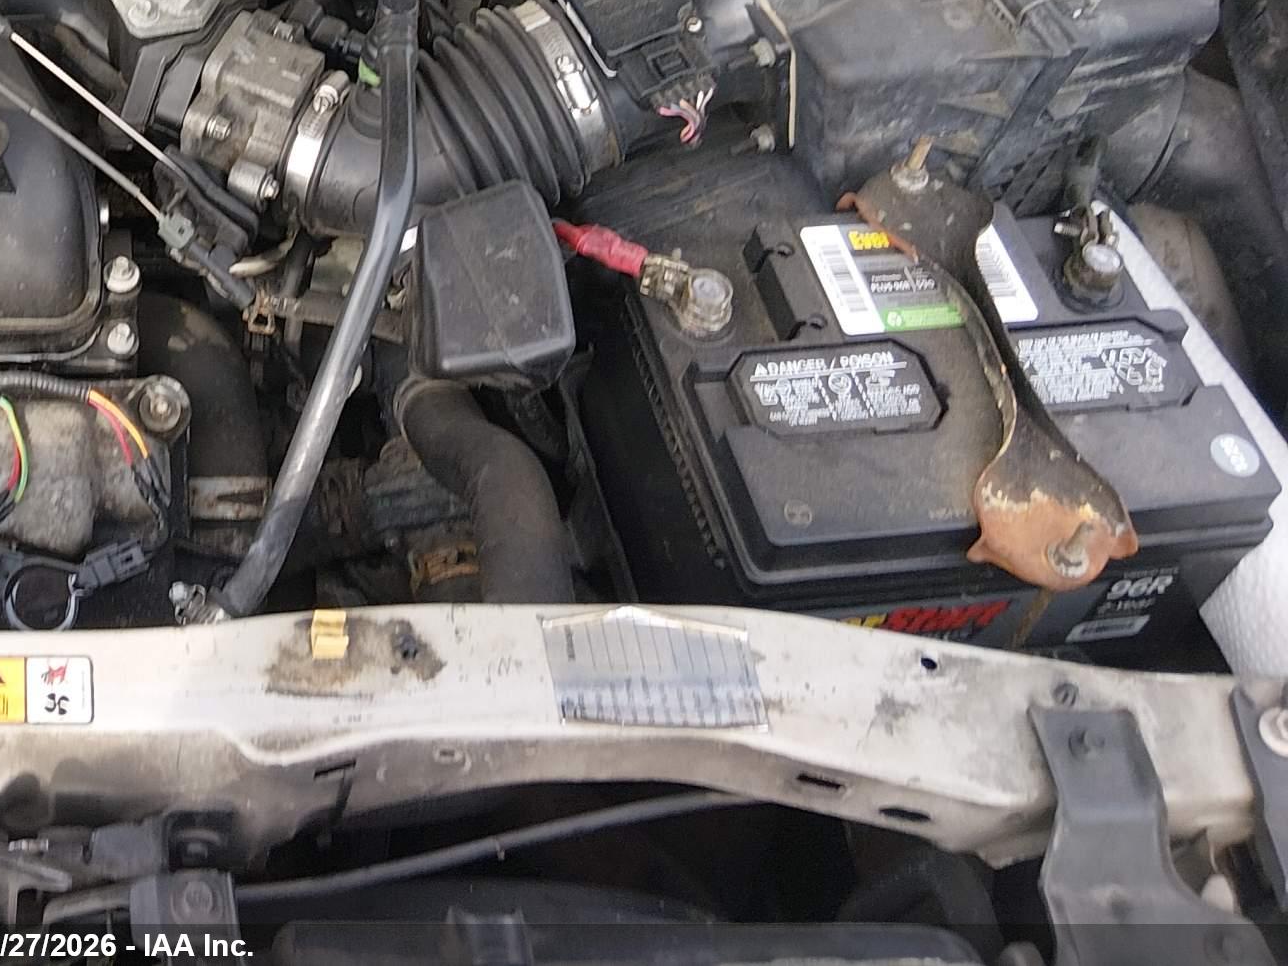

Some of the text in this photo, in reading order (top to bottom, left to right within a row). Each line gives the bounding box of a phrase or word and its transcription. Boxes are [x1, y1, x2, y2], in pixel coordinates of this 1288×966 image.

[767, 358, 827, 376] DANGER
[839, 351, 894, 369] POISON
[1106, 576, 1174, 600] 96R
